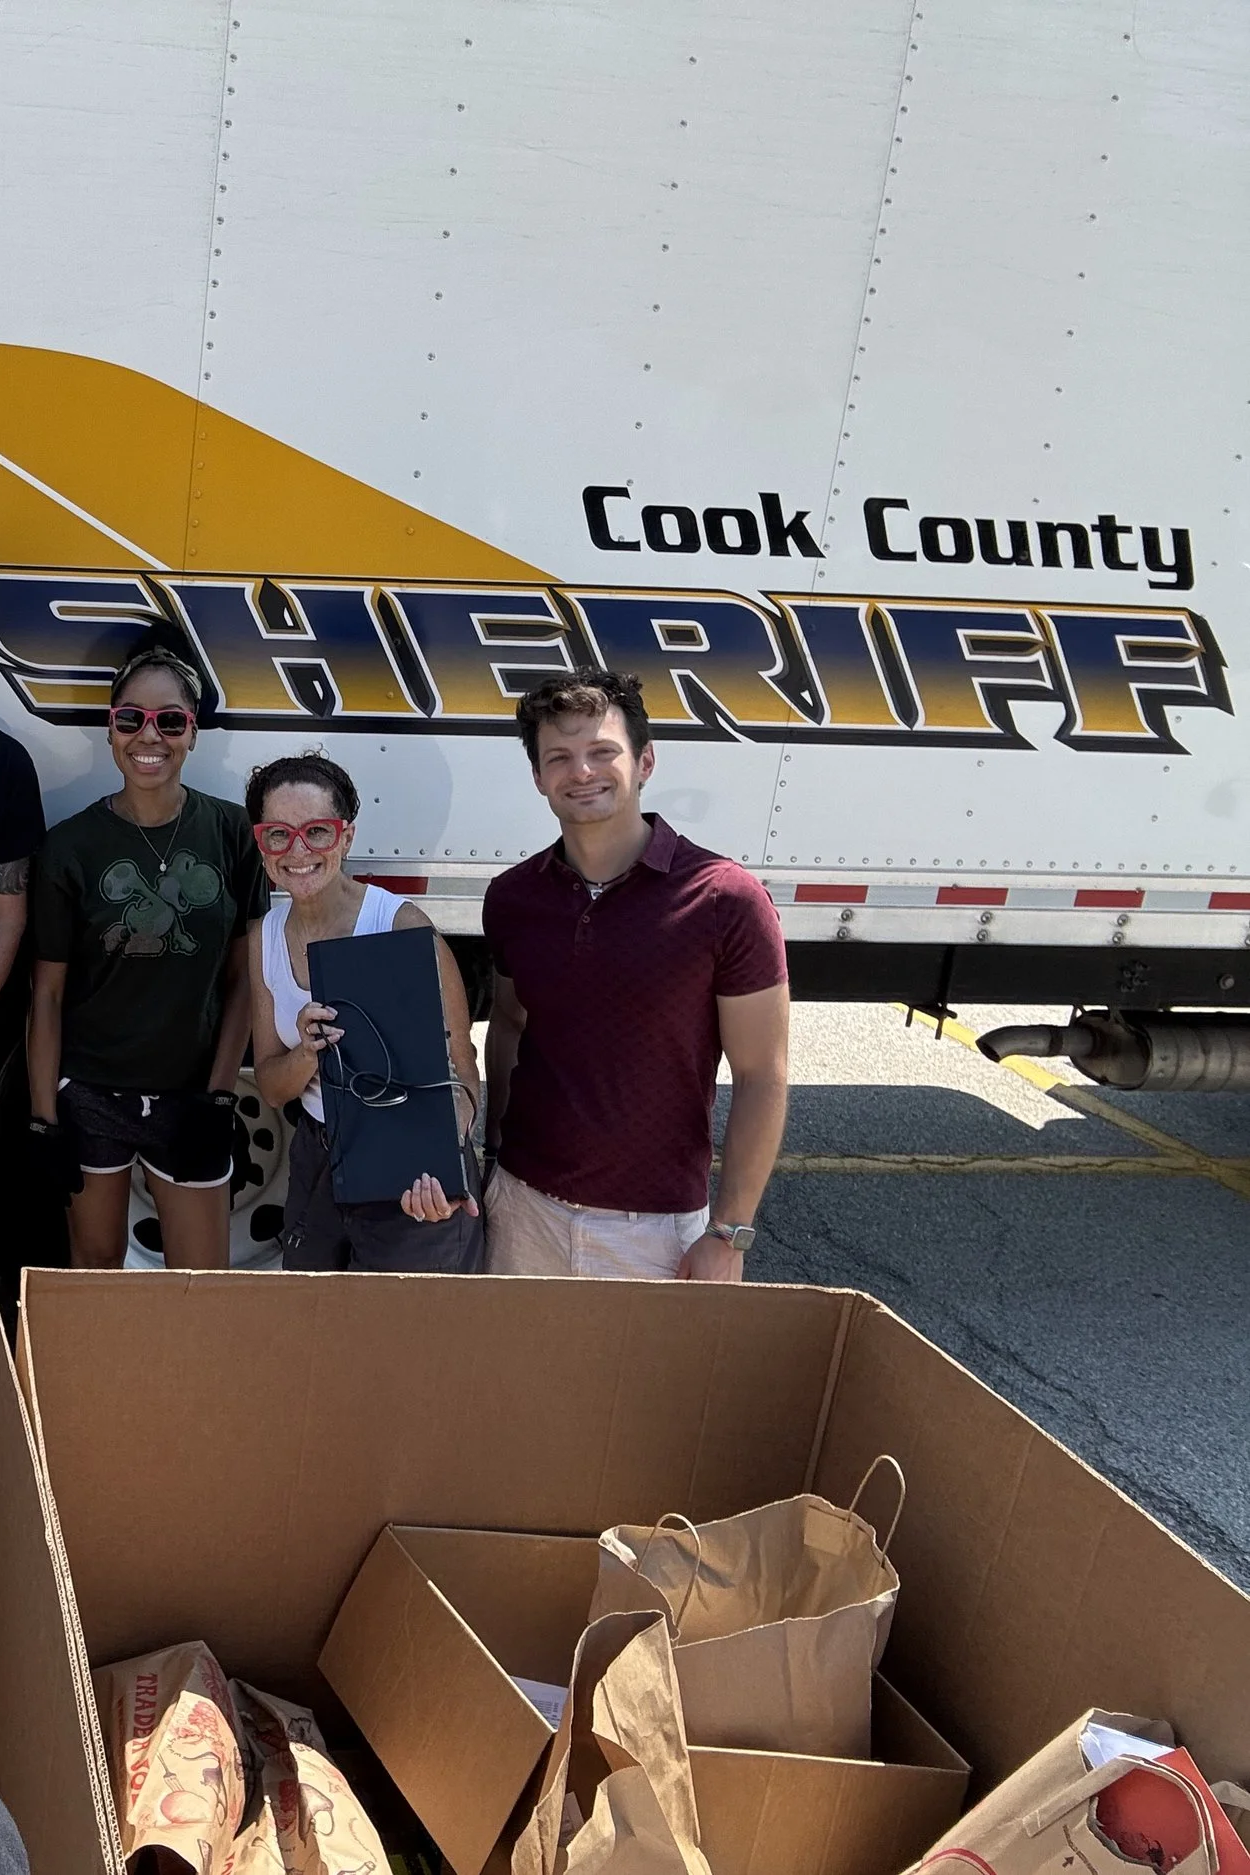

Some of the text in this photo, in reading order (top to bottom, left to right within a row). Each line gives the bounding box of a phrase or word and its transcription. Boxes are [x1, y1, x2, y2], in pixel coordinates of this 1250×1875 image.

[582, 486, 1194, 590] Cook County
[132, 1673, 158, 1755] TRADER
